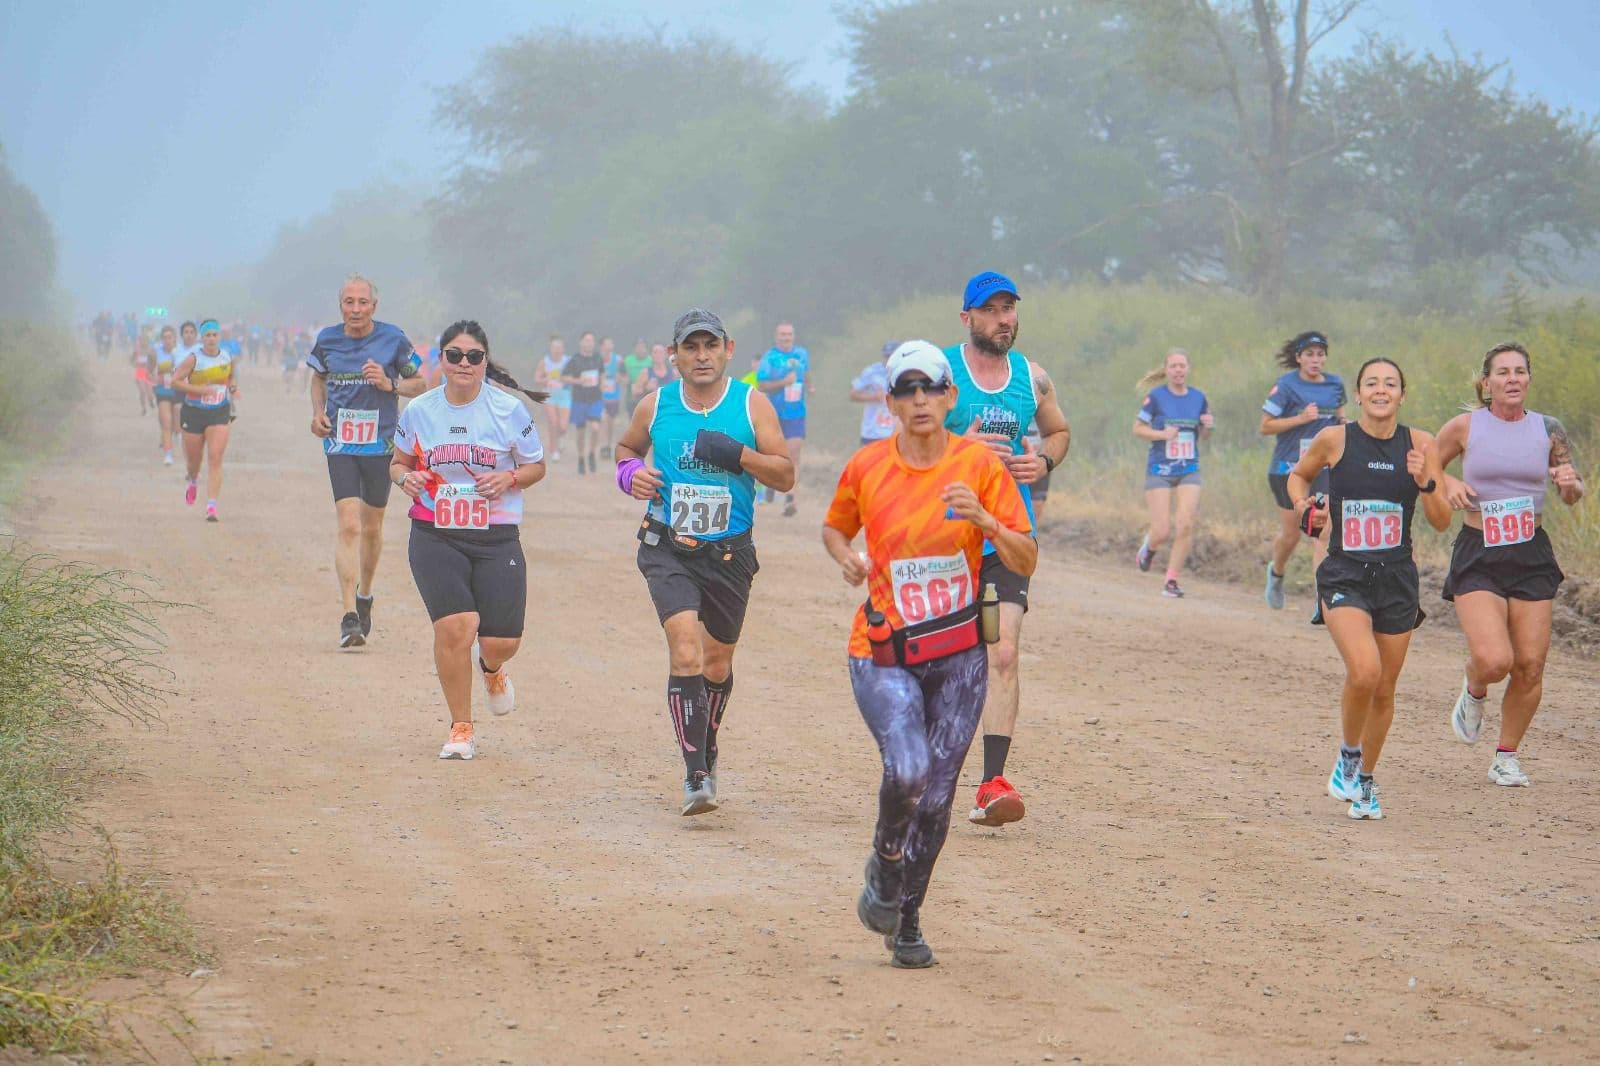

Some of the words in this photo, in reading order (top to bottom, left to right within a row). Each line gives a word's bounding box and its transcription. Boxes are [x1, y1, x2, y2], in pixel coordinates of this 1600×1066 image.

[341, 421, 375, 443] 617
[1368, 461, 1395, 471] adidas
[435, 498, 488, 527] 605
[672, 501, 729, 534] 234
[1485, 511, 1533, 544] 696
[1344, 515, 1400, 548] 803
[900, 573, 968, 622] 667
